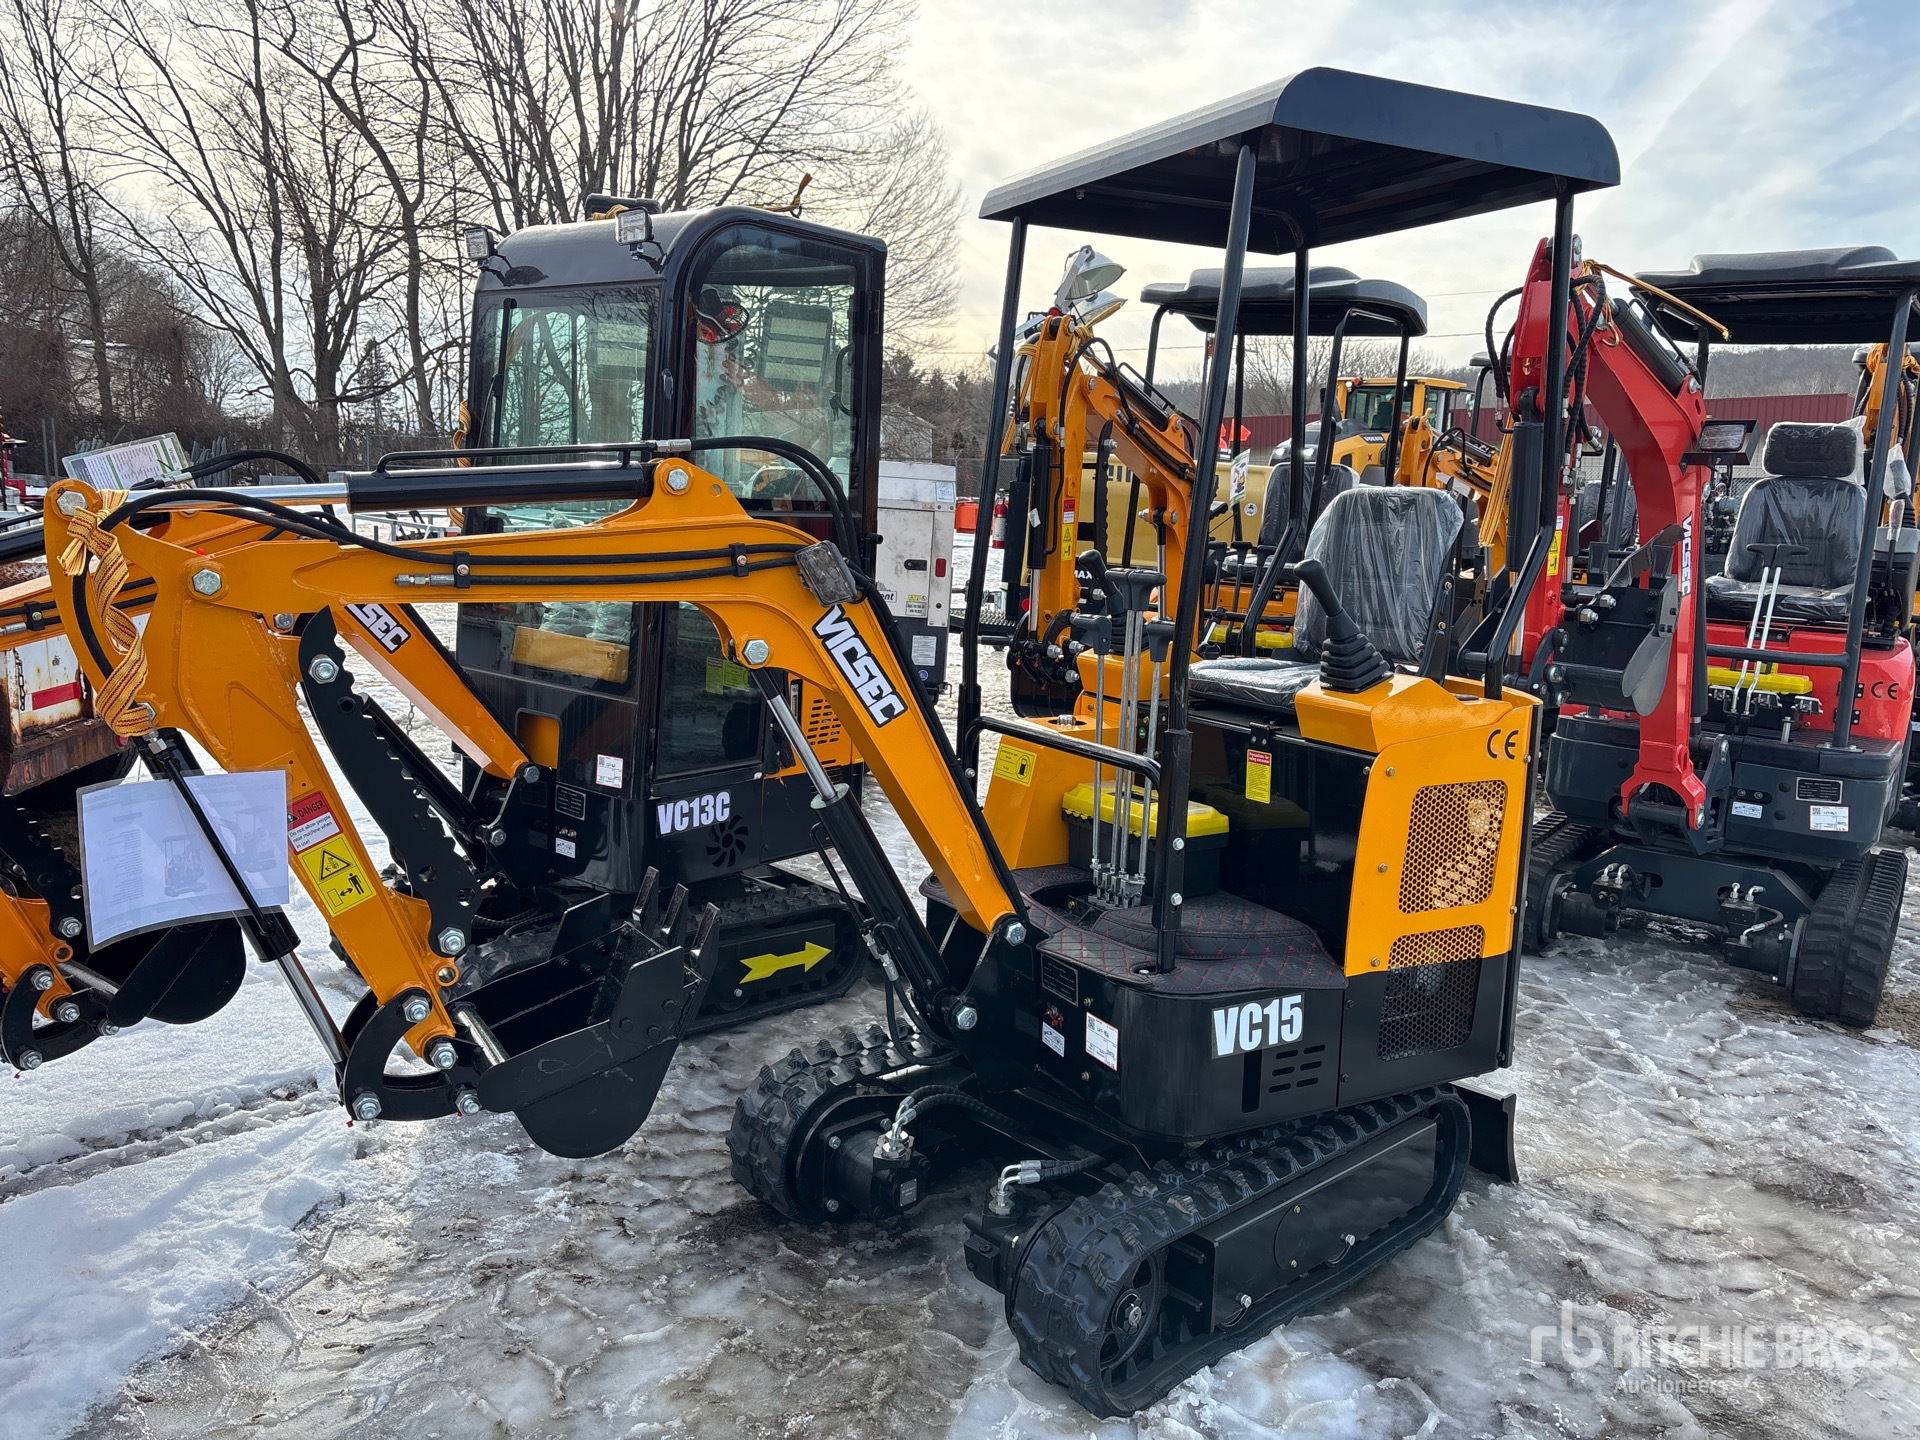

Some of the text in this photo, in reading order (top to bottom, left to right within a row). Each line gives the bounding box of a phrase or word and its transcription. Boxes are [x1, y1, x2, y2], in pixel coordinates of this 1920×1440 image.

[813, 604, 907, 727] VICSEC
[1870, 681, 1900, 700] CE
[1486, 728, 1519, 760] CE
[298, 799, 326, 818] DANGER
[657, 791, 731, 835] VC13C
[289, 815, 331, 838] Do not allow people
[293, 822, 333, 843] near machine when
[1213, 994, 1303, 1056] VC15
